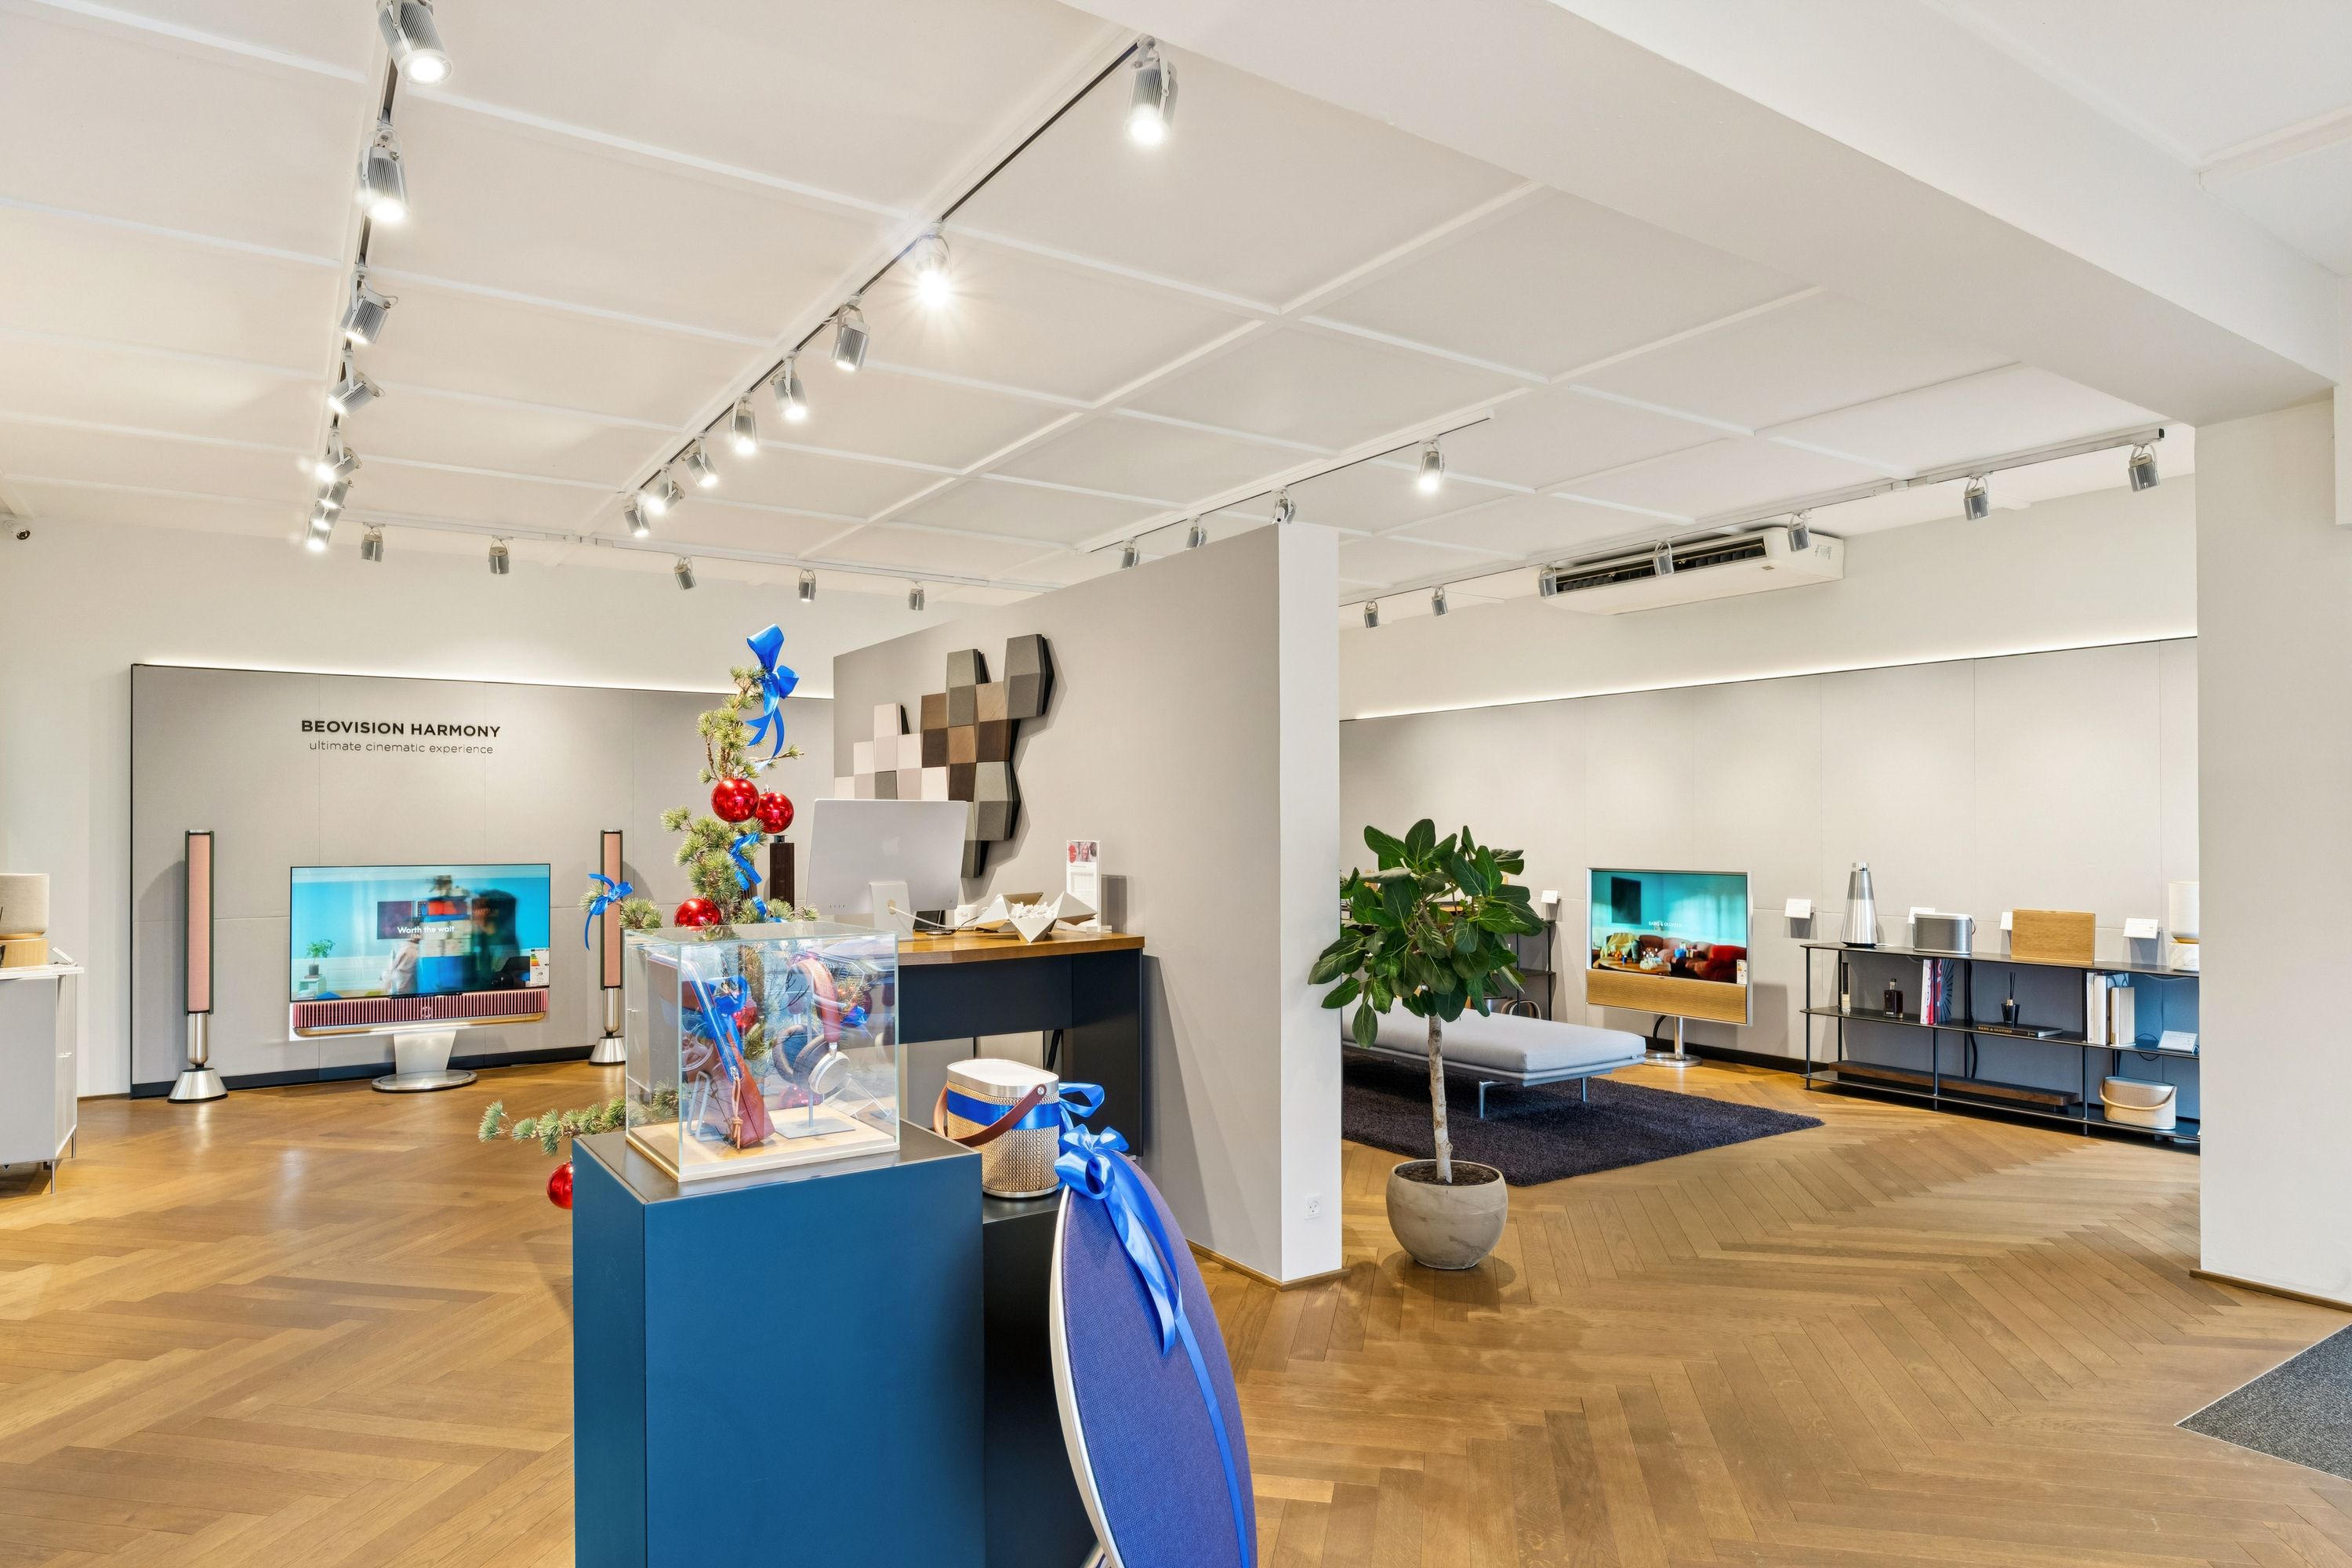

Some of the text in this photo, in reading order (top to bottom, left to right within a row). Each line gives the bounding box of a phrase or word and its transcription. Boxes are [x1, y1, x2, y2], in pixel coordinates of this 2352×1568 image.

[301, 720, 501, 738] BEOVISION HARMONY
[309, 740, 493, 755] ultimate cinematic experience
